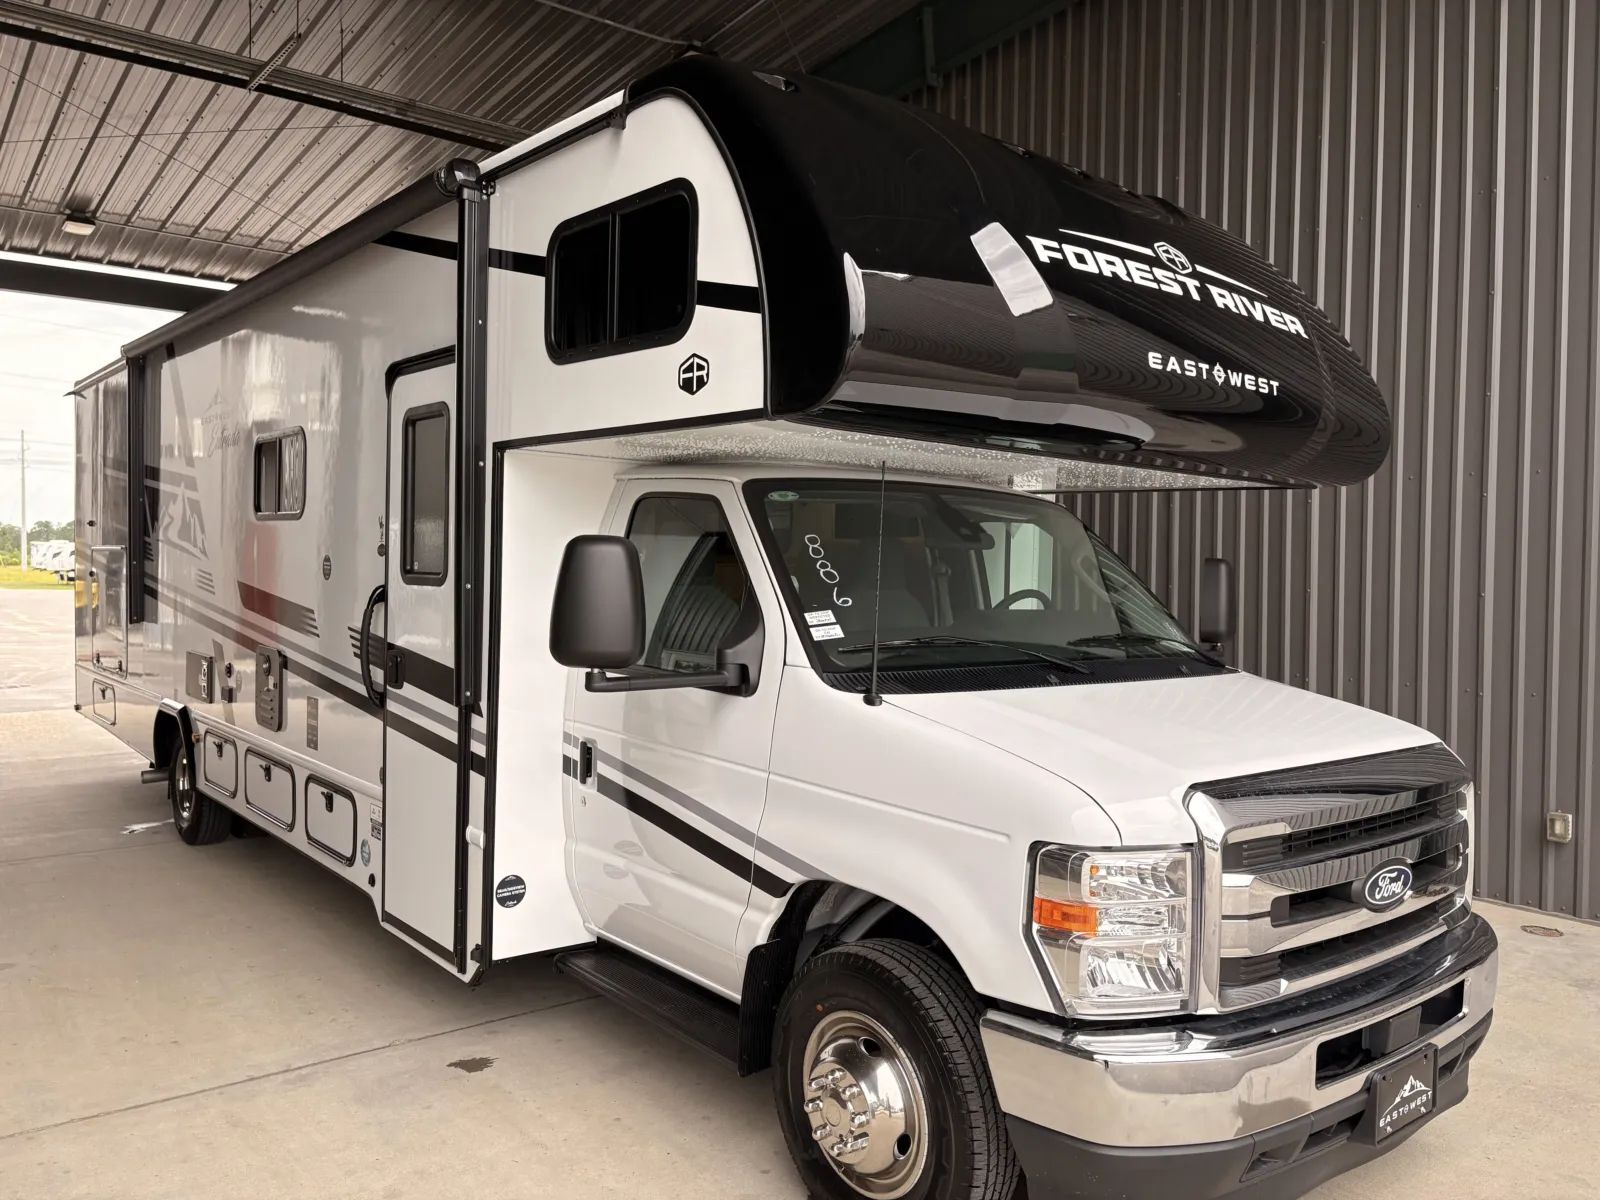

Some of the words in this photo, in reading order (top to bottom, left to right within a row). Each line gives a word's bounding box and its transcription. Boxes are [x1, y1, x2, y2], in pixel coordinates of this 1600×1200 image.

[1025, 235, 1201, 301] FOREST
[1205, 284, 1309, 339] RIVER
[805, 534, 852, 606] 886
[1375, 871, 1405, 900] Ford
